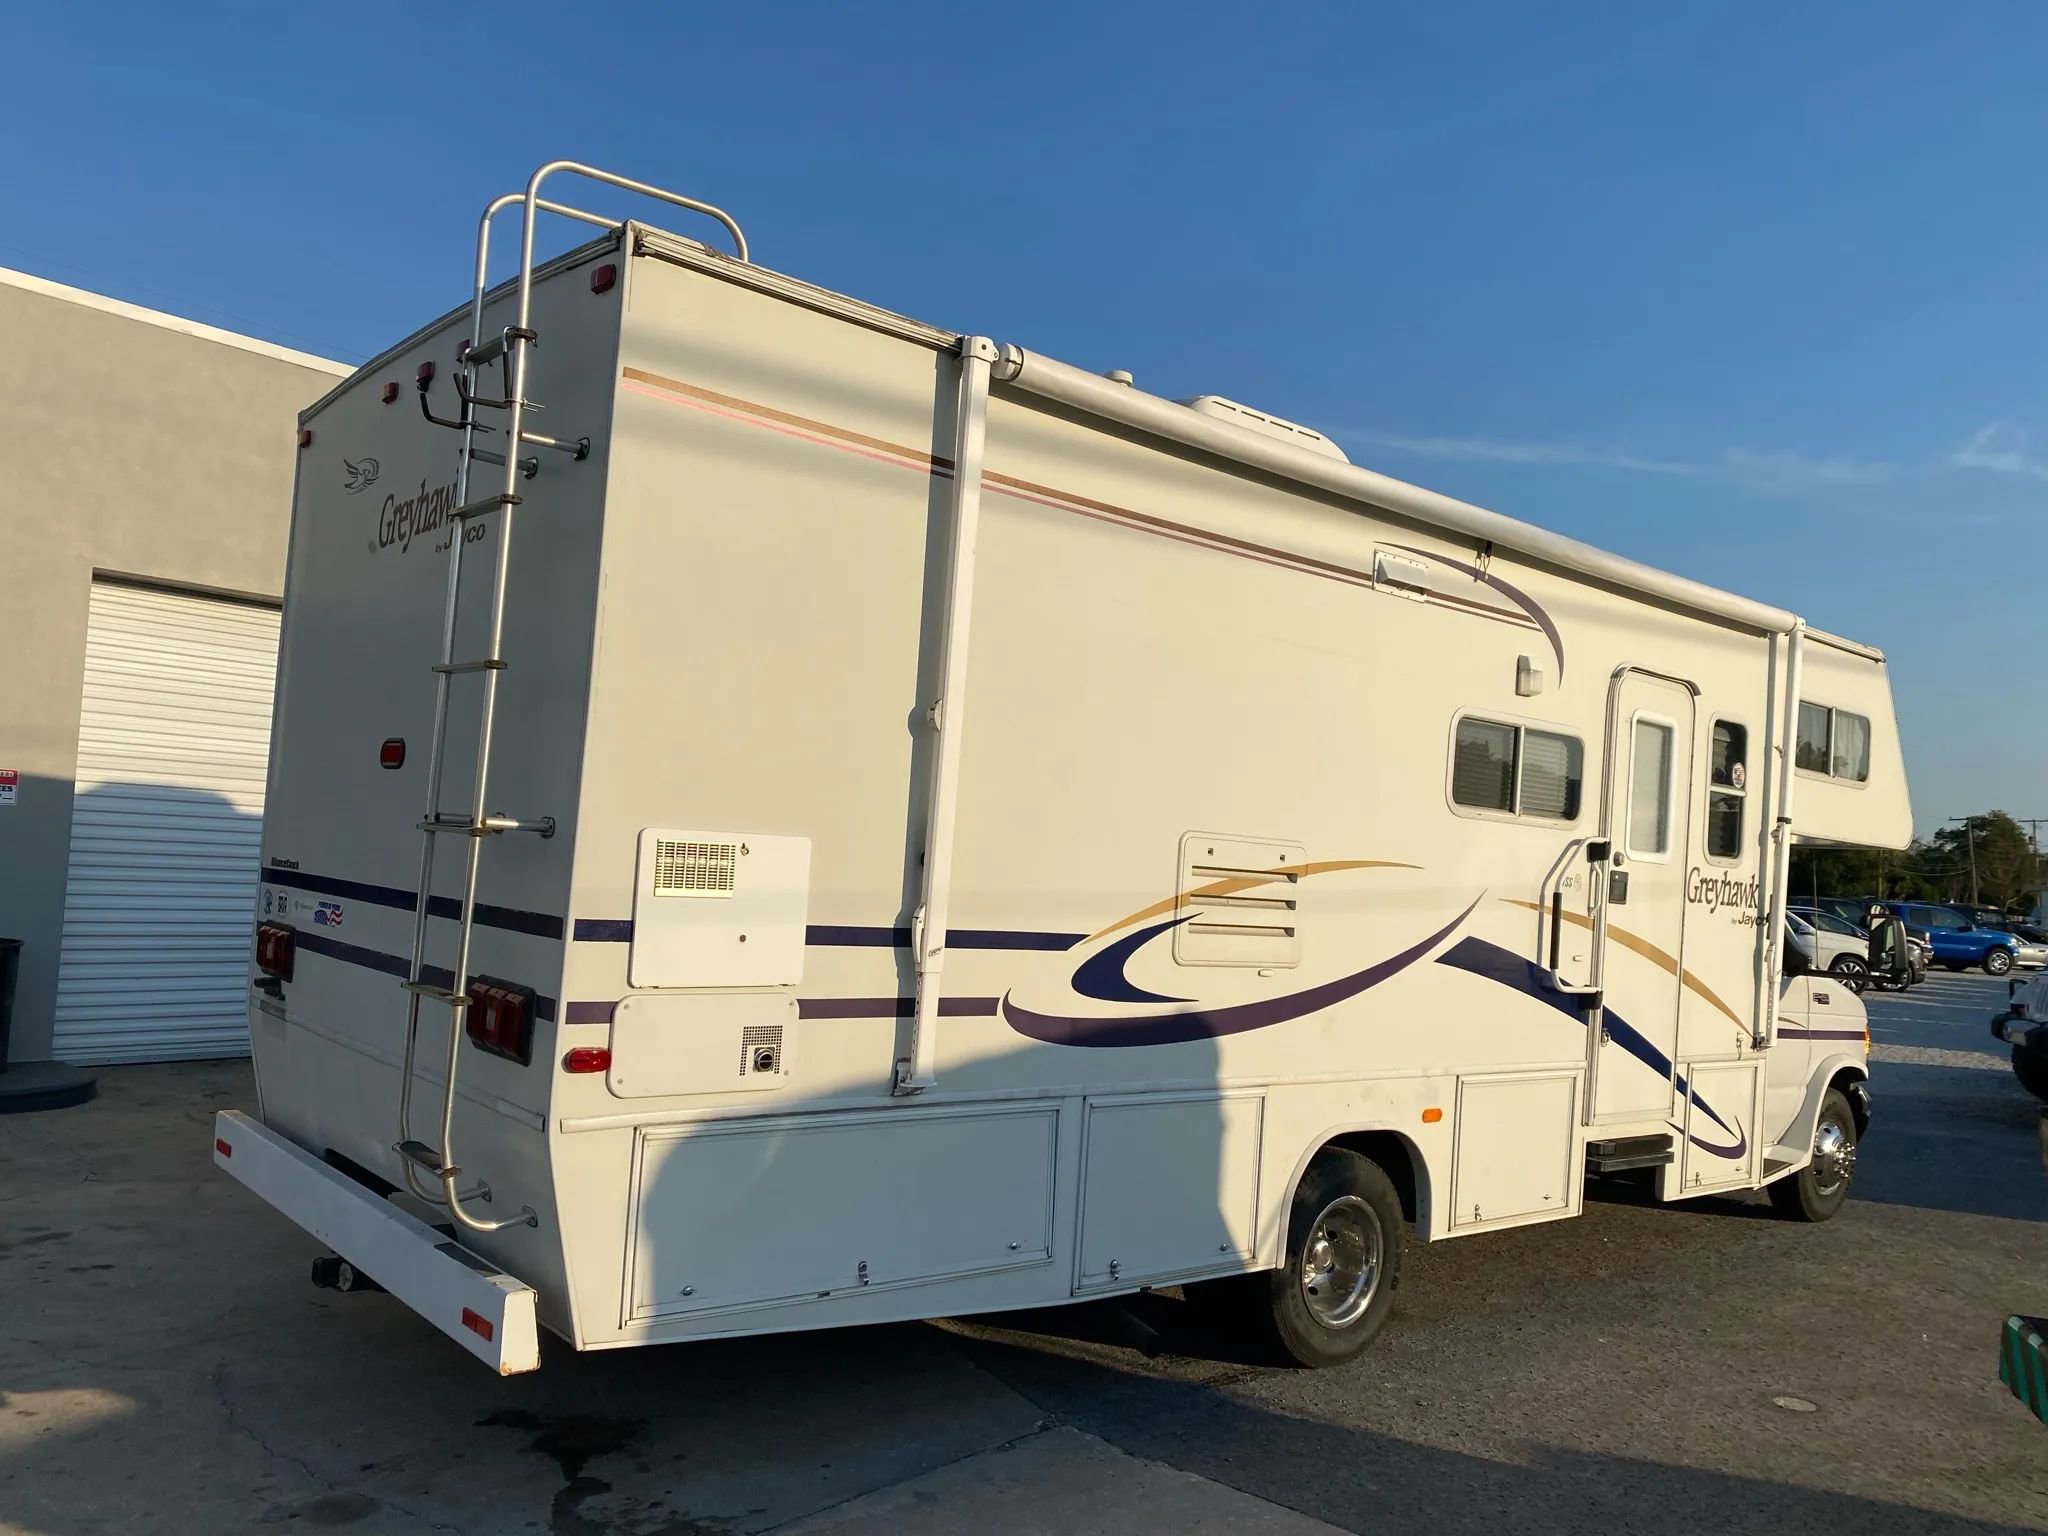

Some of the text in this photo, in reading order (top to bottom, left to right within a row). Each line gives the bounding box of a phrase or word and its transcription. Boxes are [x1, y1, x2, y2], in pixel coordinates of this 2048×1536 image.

[379, 466, 459, 553] Greyhaw
[1687, 866, 1760, 914] Greyhawk
[1738, 911, 1768, 928] Jayco
